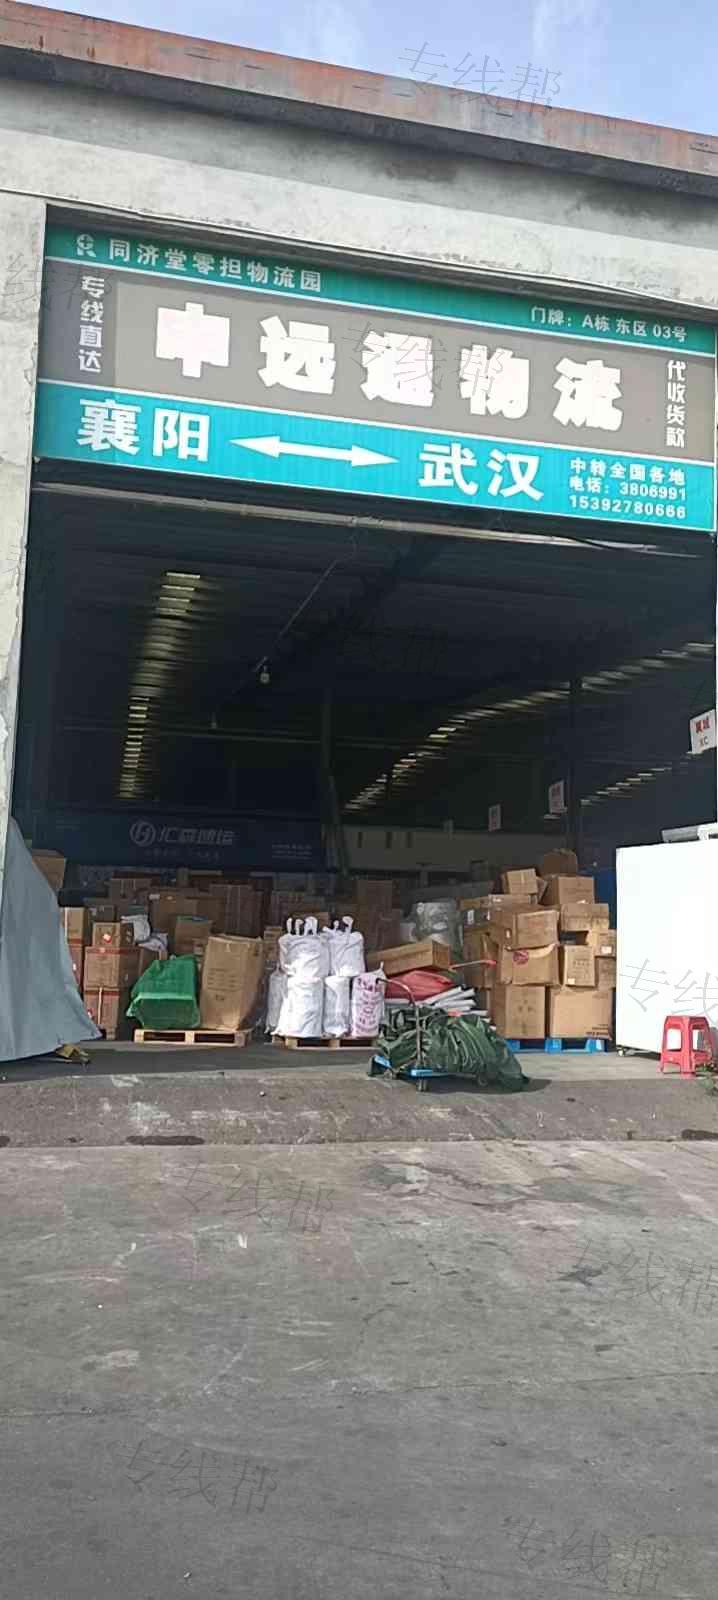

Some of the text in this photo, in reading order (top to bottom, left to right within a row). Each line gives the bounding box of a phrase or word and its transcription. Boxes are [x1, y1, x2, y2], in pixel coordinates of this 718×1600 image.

[108, 239, 322, 293] 同济堂零担物流园
[78, 275, 105, 373] 专线直达
[615, 318, 647, 337] 东区
[653, 325, 687, 343] 03号
[76, 398, 211, 462] 襄阳
[666, 359, 687, 448] 代收货款
[418, 442, 545, 501] 武汉
[569, 456, 686, 486] 中转全国各地
[569, 495, 687, 519] 15392780666
